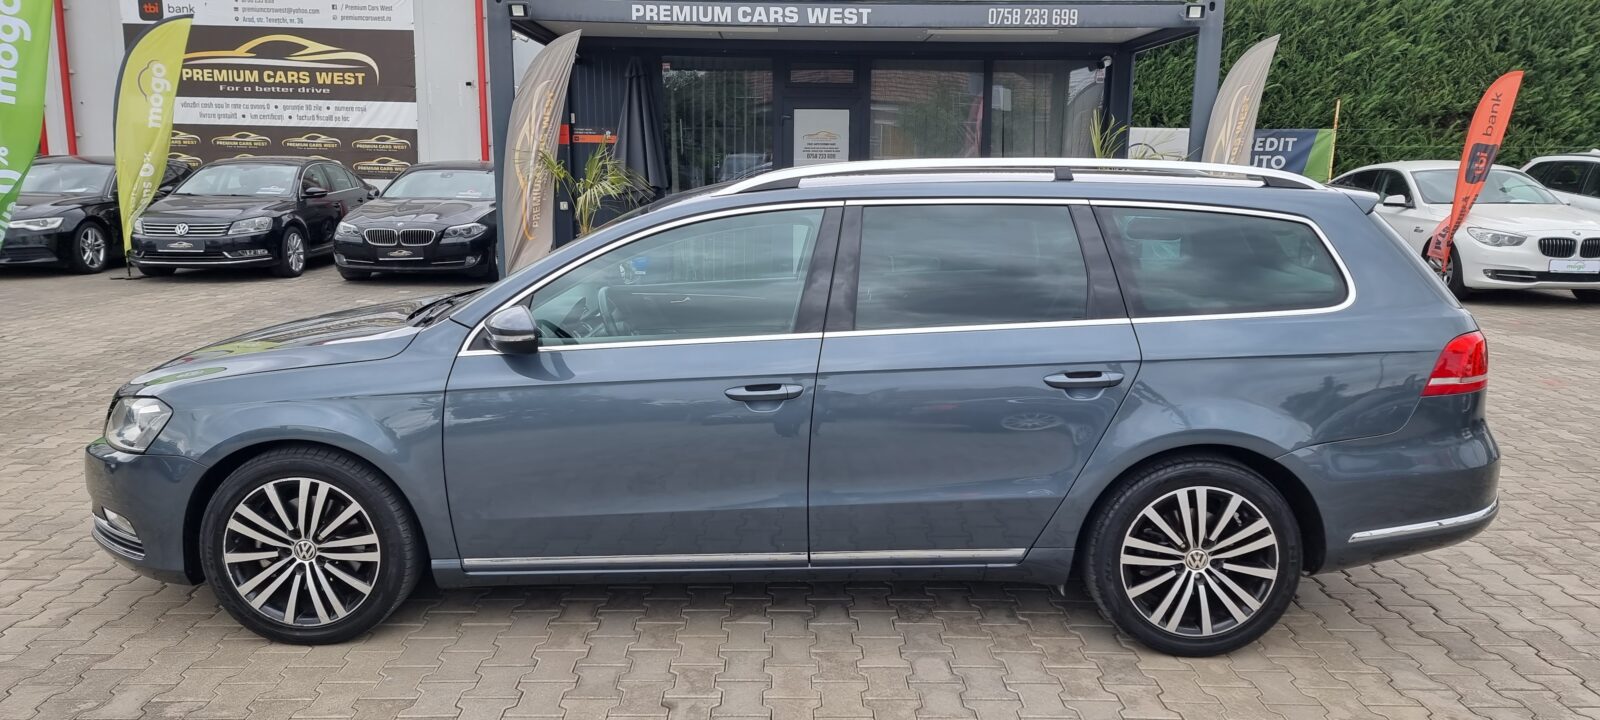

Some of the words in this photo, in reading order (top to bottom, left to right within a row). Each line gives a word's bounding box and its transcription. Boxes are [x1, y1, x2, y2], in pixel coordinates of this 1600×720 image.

[143, 3, 159, 13] tbi
[167, 3, 196, 14] bank
[631, 4, 732, 22] PREMIUM
[737, 6, 799, 23] CARS
[807, 7, 872, 25] WEST
[988, 8, 1021, 25] 0758
[1024, 8, 1049, 25] 233
[1052, 9, 1079, 26] 699
[182, 68, 259, 83] PREMIUM
[263, 70, 311, 84] CARS
[316, 71, 366, 86] WEST
[148, 62, 171, 128] mogo
[219, 84, 242, 92] For
[255, 85, 295, 93] better
[298, 86, 331, 94] drive
[1474, 151, 1488, 175] tbi
[1482, 92, 1504, 137] bank
